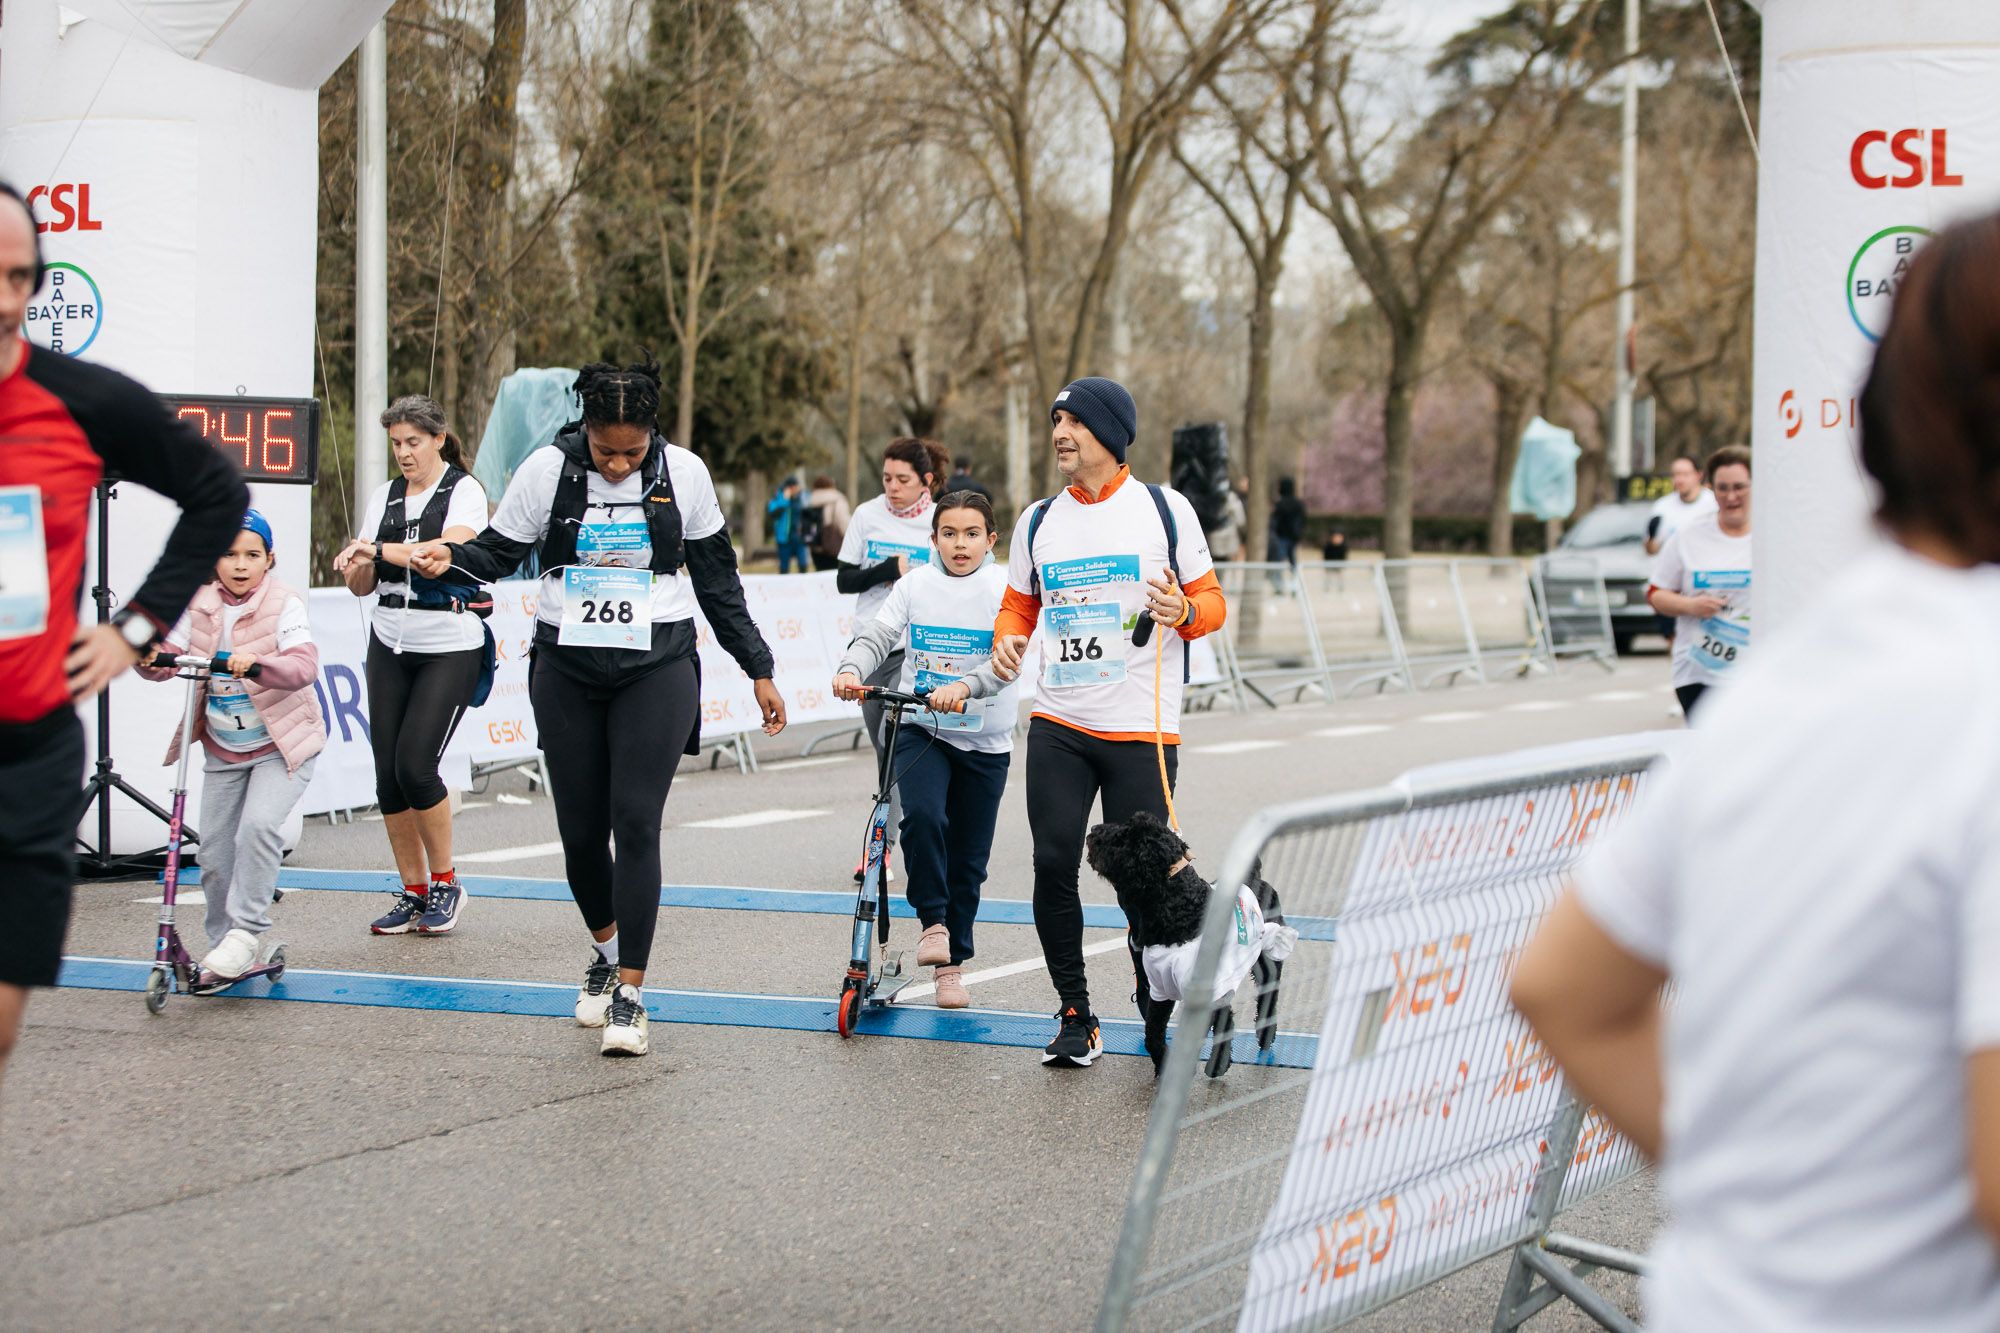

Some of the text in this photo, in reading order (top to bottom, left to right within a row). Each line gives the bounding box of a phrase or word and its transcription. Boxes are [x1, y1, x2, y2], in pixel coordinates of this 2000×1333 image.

[1850, 128, 1963, 189] CSL
[27, 304, 94, 320] BAYER
[1820, 399, 1854, 428] DI
[1056, 565, 1084, 575] Carrera
[1085, 561, 1117, 571] Solidaria
[1109, 573, 1136, 583] 2026
[582, 600, 634, 624] 268
[1057, 613, 1076, 621] Carrera
[924, 631, 949, 640] Carrera
[950, 632, 980, 642] Solidaria
[1060, 636, 1103, 663] 136
[1702, 635, 1738, 662] 208
[234, 715, 246, 730] 1
[488, 719, 527, 745] GSK
